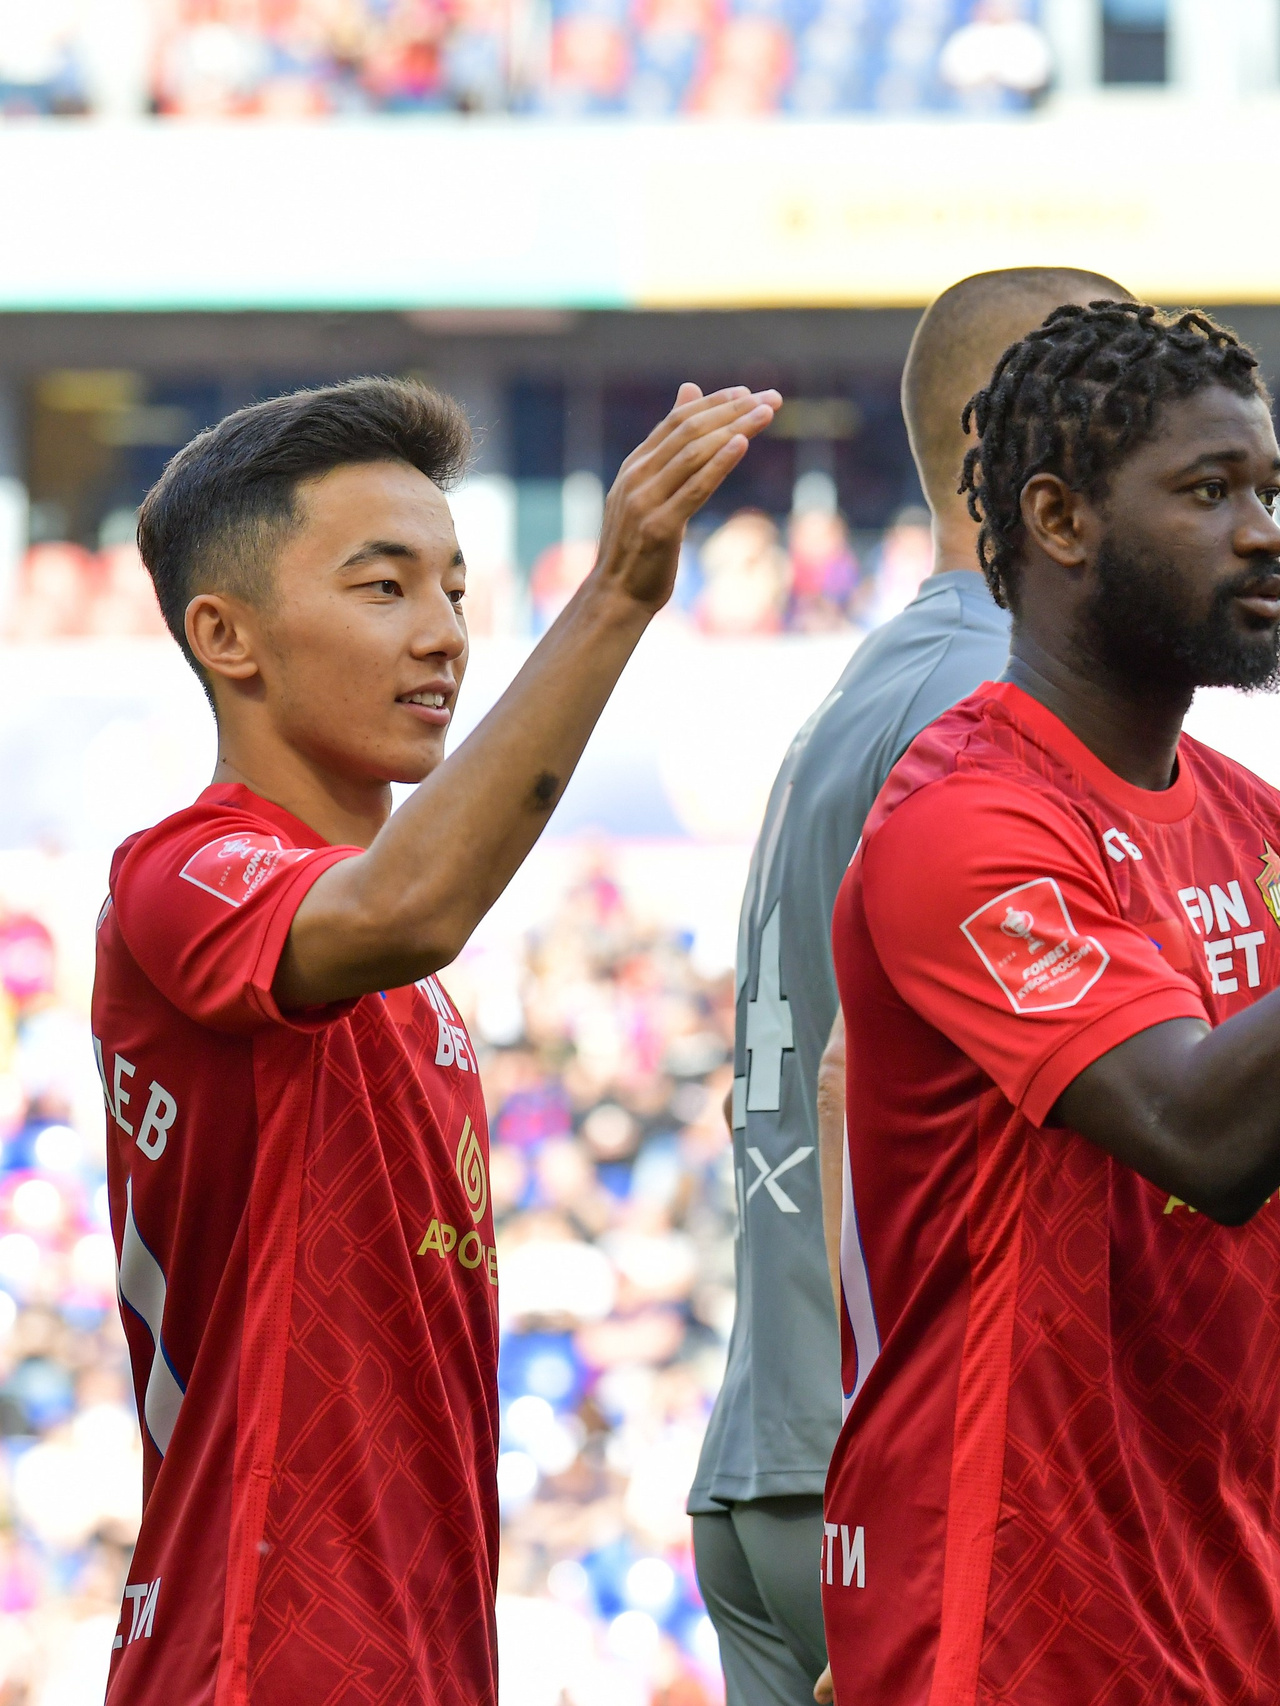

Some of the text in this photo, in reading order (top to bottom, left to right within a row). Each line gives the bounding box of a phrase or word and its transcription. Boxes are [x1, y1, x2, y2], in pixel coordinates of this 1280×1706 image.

[1022, 939, 1070, 980] FONBET
[1203, 930, 1266, 995] ET
[820, 1522, 866, 1588] ТИ
[112, 1577, 162, 1650] ТИ
